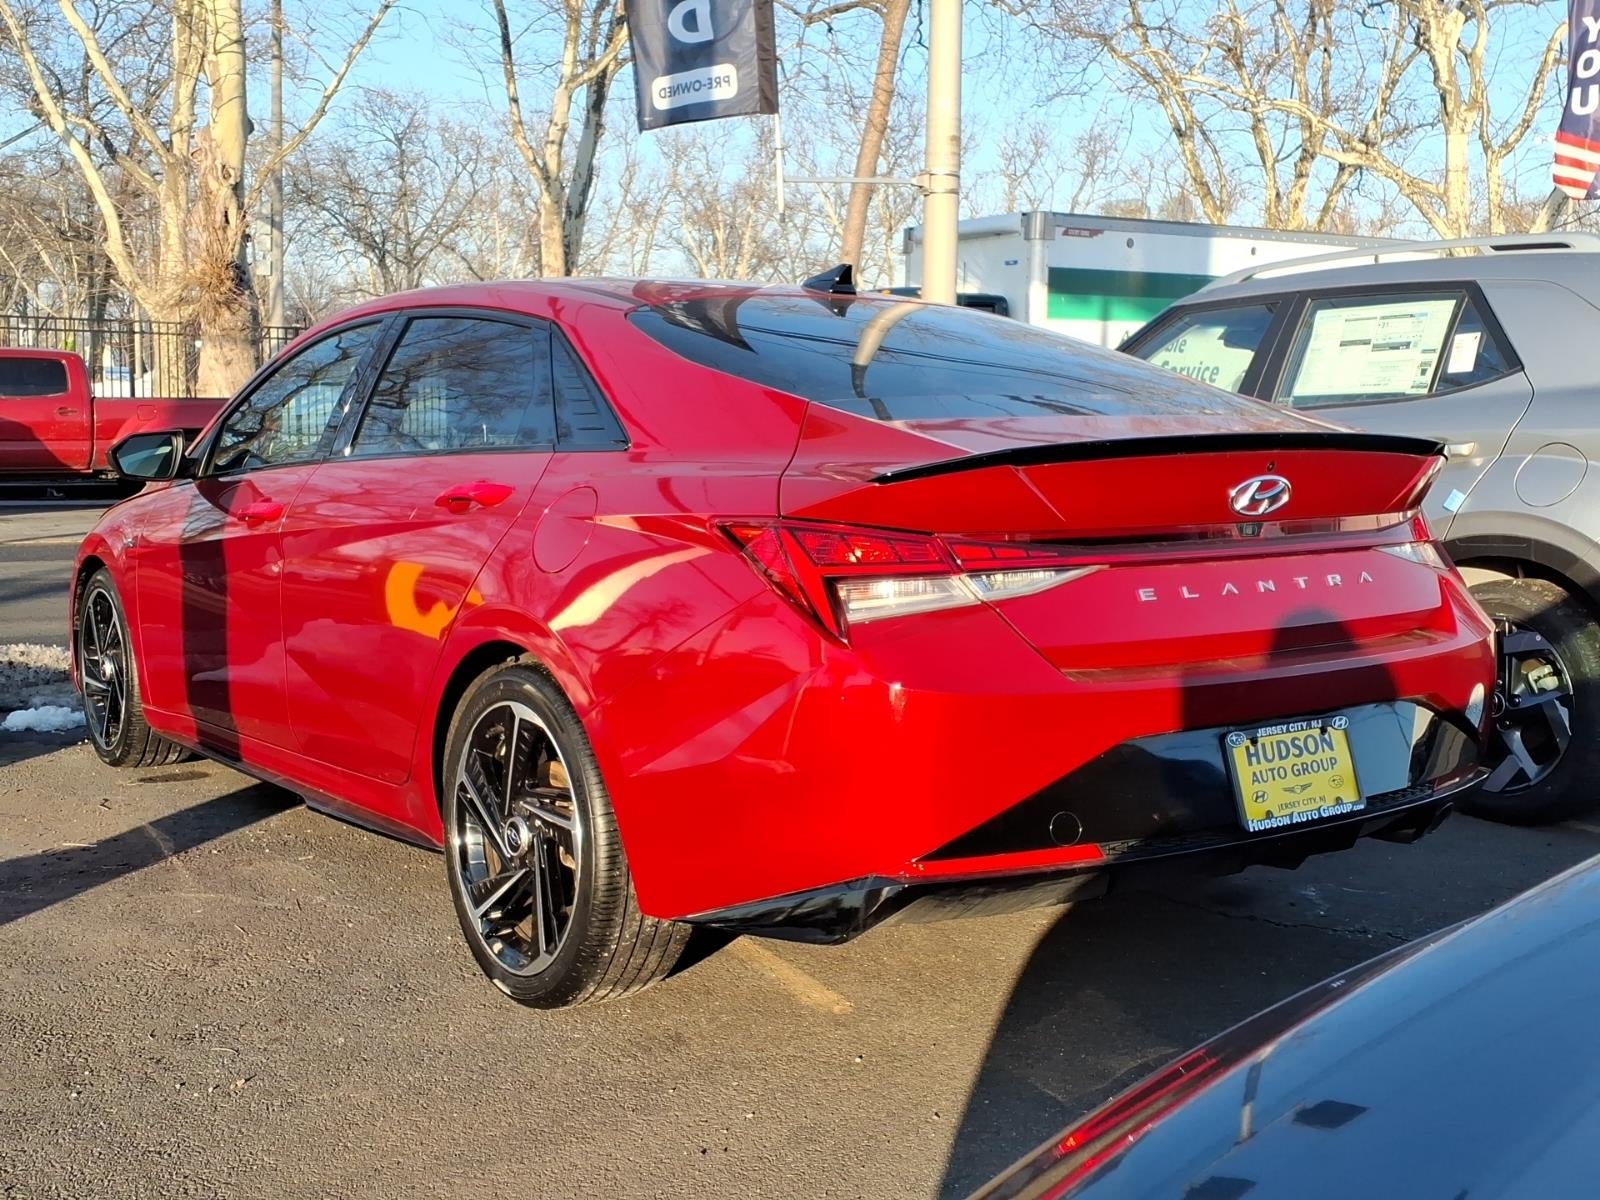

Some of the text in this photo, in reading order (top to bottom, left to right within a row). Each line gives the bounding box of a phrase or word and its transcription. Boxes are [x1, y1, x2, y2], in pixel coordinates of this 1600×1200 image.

[1137, 571, 1374, 601] ELANTRA
[1256, 724, 1287, 737] JERSEY
[1244, 730, 1335, 767] HUDSON
[1251, 756, 1338, 786] AUTO GROUP
[1277, 800, 1301, 813] JERSEY
